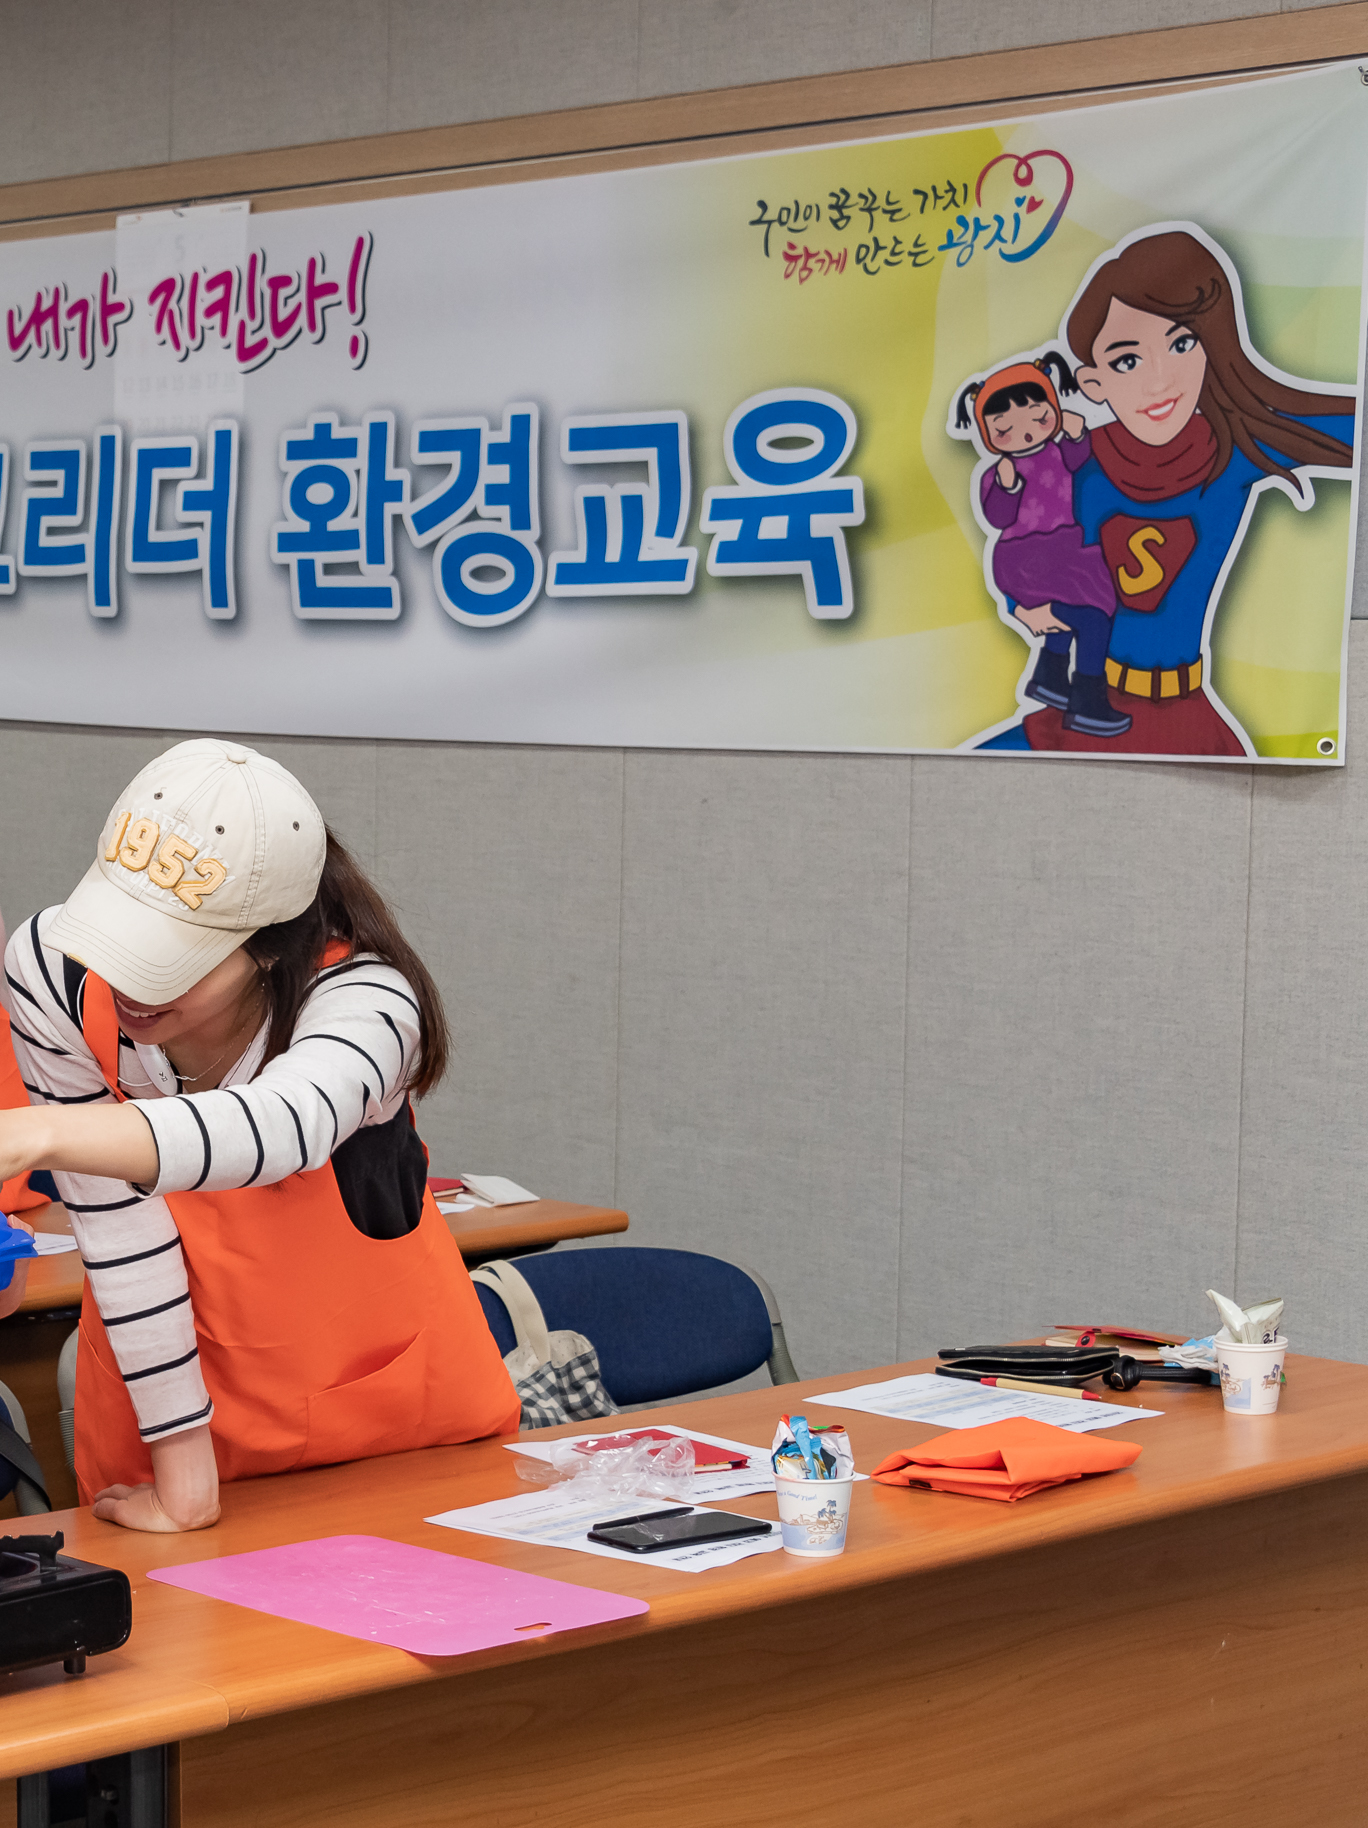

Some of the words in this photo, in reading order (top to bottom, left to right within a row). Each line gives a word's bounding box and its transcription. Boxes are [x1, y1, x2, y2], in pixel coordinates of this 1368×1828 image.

[748, 199, 821, 259] 구민이
[827, 187, 911, 233] 꿈꾸는
[912, 179, 969, 215] 가치
[781, 241, 848, 286] 함께
[854, 232, 936, 277] 만드는
[7, 270, 131, 368] 내가
[148, 231, 376, 375] 지킨다!
[274, 388, 865, 628] 환경교육
[1116, 525, 1167, 597] S
[104, 811, 228, 912] 1952
[118, 807, 237, 894] CALIFORN
